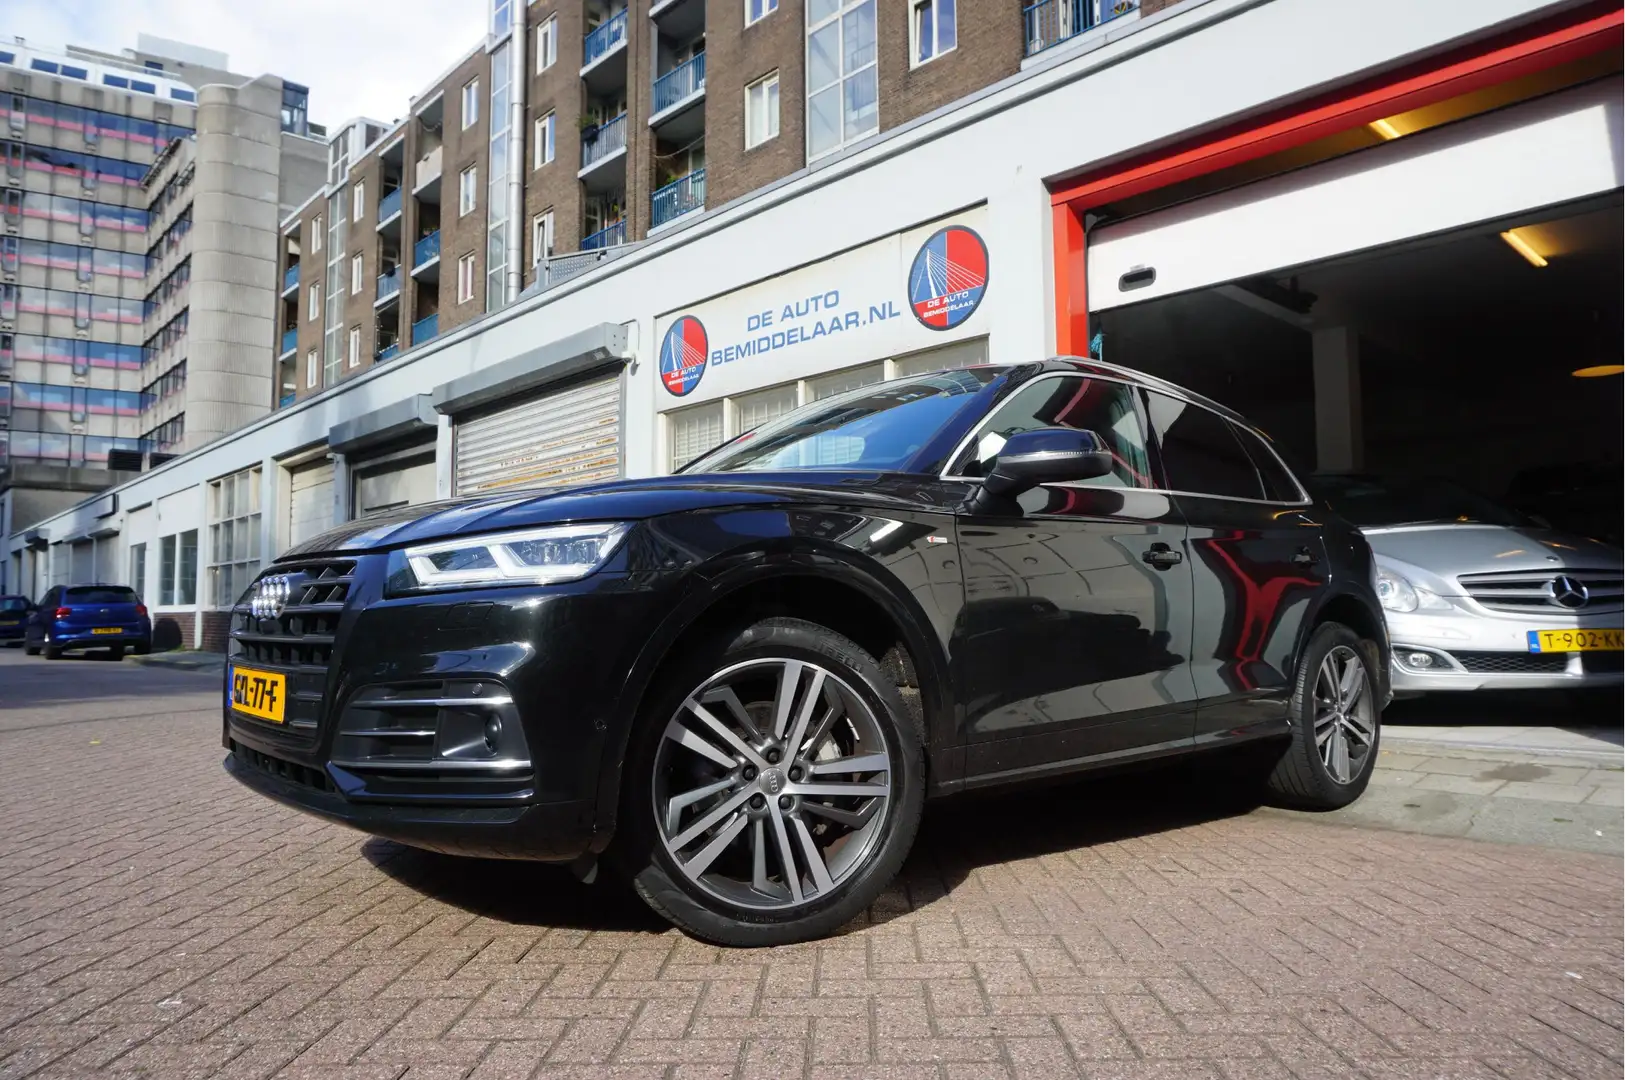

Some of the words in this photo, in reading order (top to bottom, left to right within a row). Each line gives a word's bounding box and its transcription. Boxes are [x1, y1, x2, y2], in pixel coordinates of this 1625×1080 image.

[923, 299, 974, 318] BEMIDDELAAR
[927, 297, 941, 309] DE
[942, 290, 969, 305] AUTO
[747, 310, 773, 333] DE
[780, 290, 840, 327] AUTO
[711, 300, 901, 367] BEMIDDELAAR.NL
[680, 366, 696, 376] AUTO
